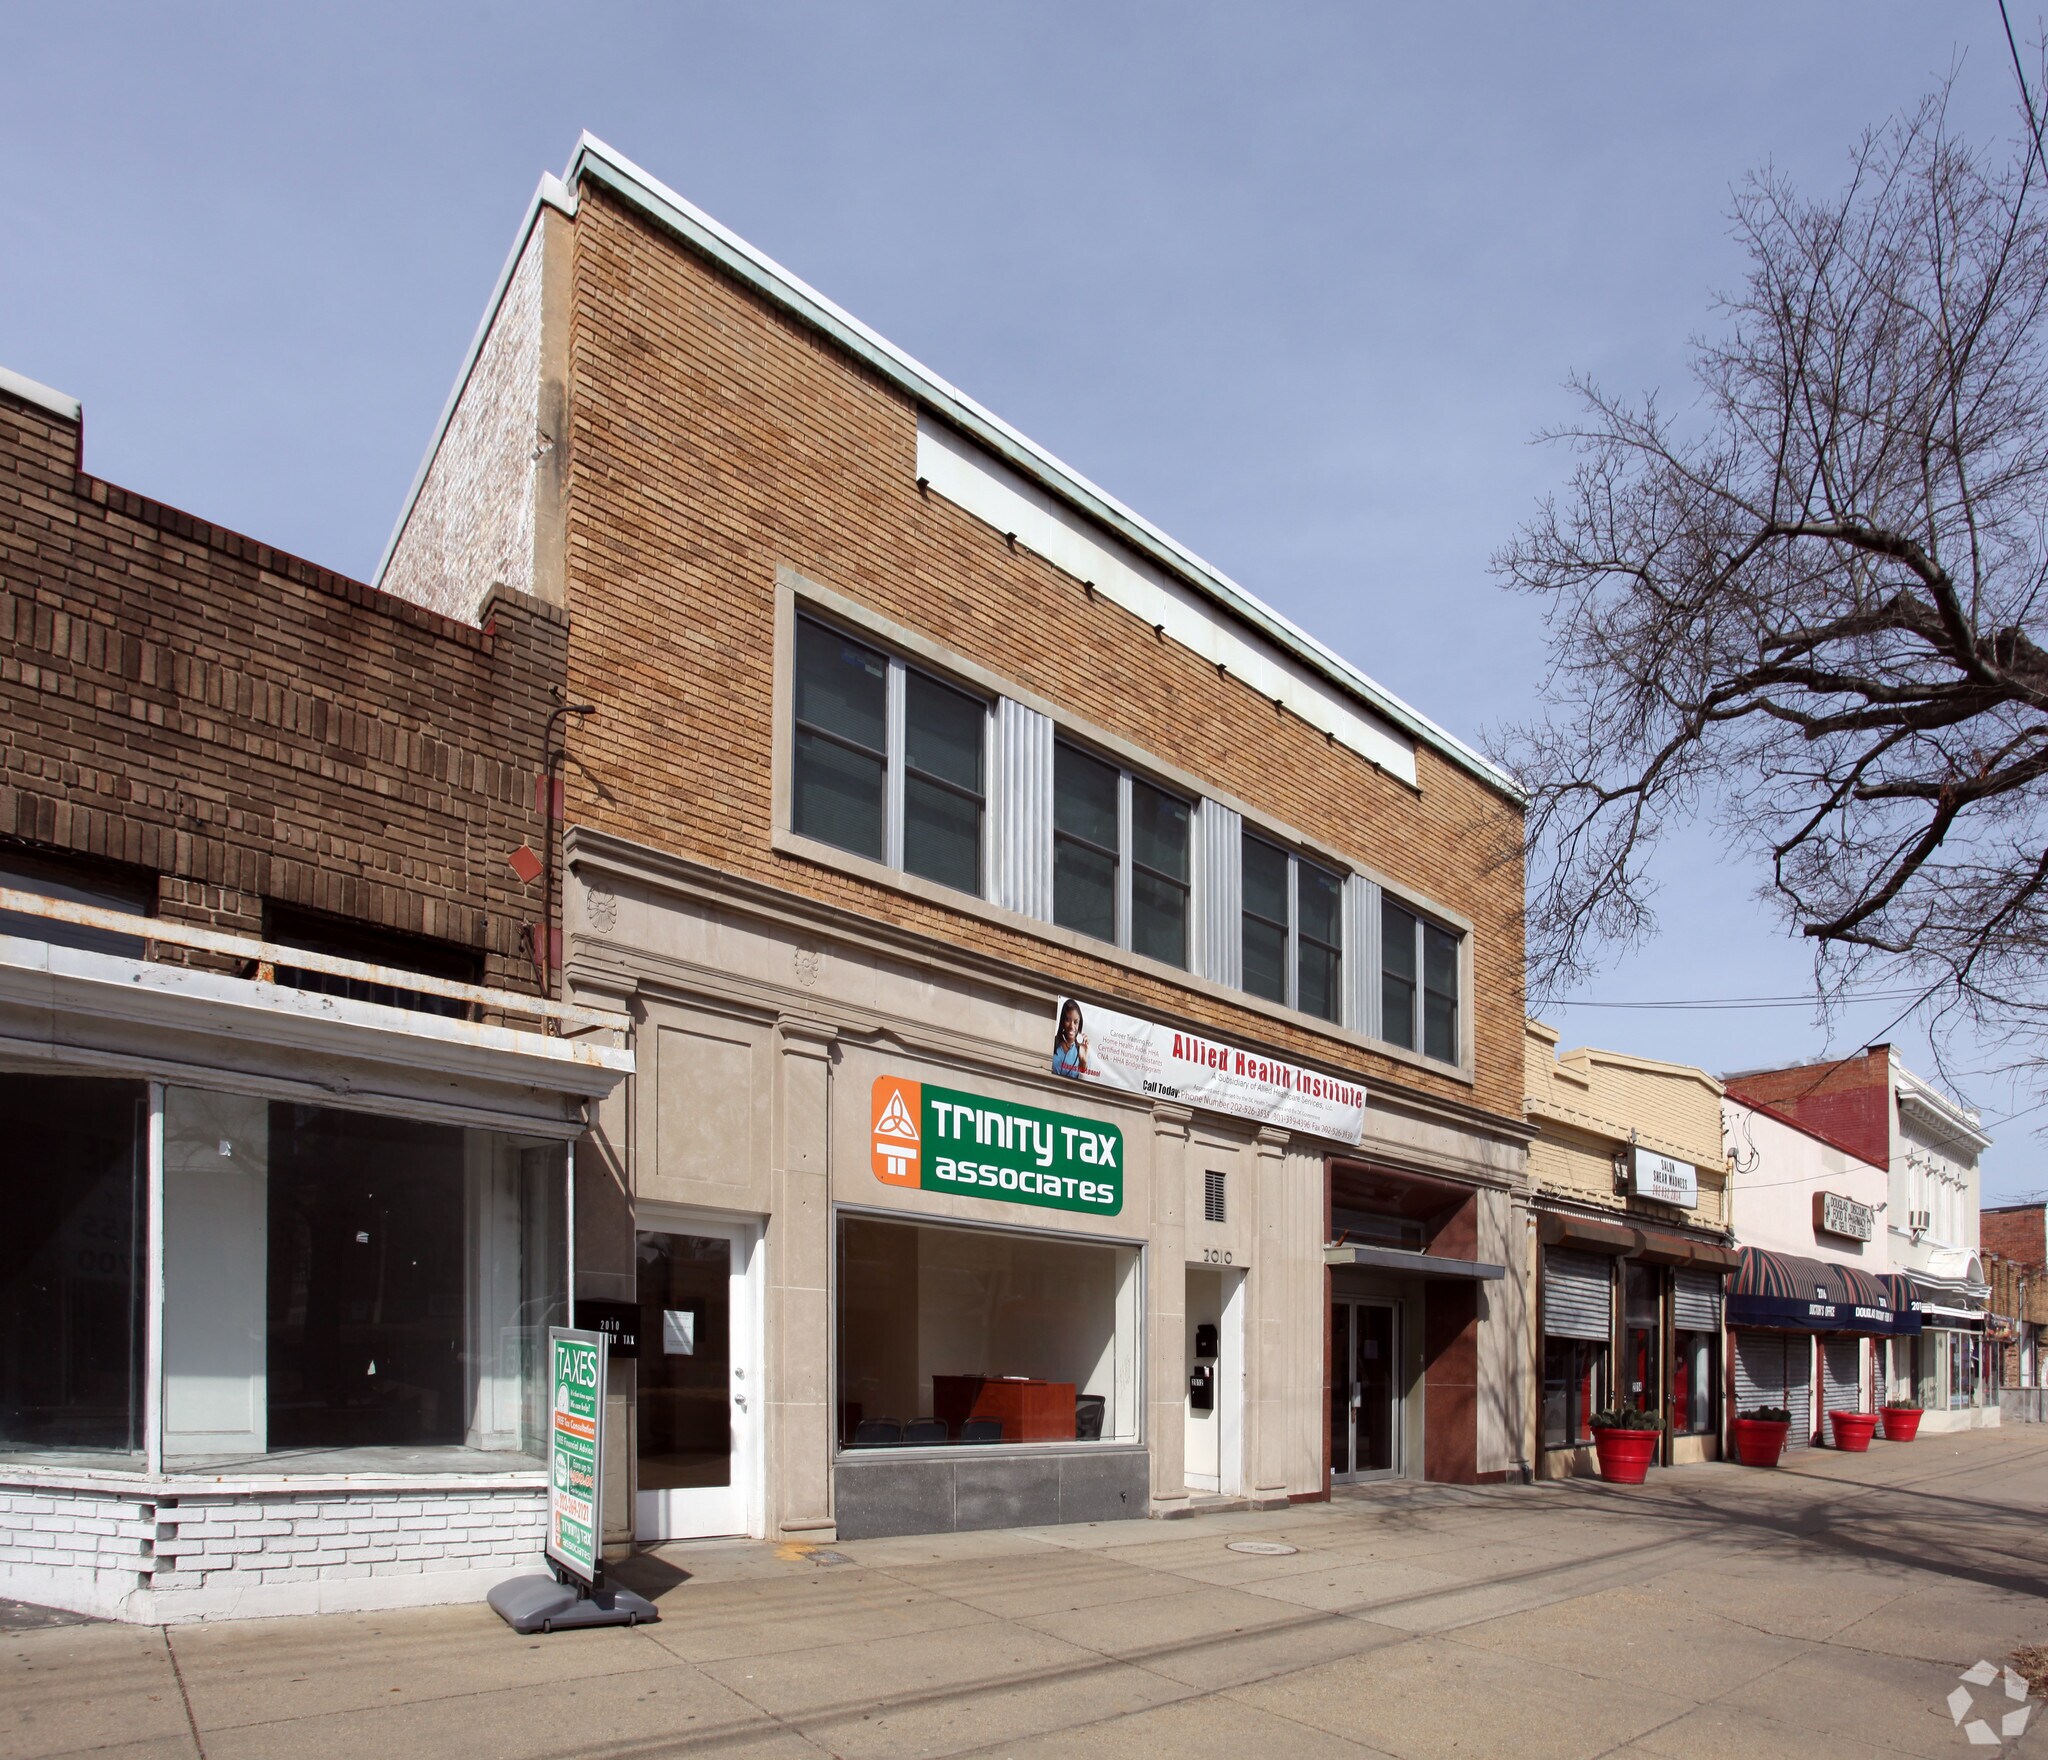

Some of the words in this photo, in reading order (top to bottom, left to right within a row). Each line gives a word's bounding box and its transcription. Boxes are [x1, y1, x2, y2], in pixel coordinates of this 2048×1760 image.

[1097, 1044, 1119, 1056] Certified
[1120, 1050, 1139, 1061] Nursing
[1102, 1036, 1118, 1046] Home
[1118, 1041, 1134, 1050] Health
[1097, 1052, 1109, 1062] CNA
[1113, 1056, 1125, 1065] HHA
[1126, 1059, 1141, 1071] Bridge
[1140, 1063, 1162, 1075] Program
[1172, 1033, 1228, 1072] Allied
[1235, 1051, 1291, 1089] Health
[1296, 1069, 1363, 1109] Institute
[1211, 1072, 1217, 1081] A
[1218, 1073, 1250, 1089] Subsidiary
[1250, 1082, 1257, 1090] of
[1257, 1083, 1273, 1095] Allied
[1273, 1089, 1301, 1103] Healthcare
[1142, 1079, 1158, 1092] Call
[1180, 1089, 1204, 1104] Phone
[1203, 1095, 1229, 1109] Number
[1311, 1121, 1321, 1132] Fax
[1661, 1159, 1675, 1174] SALON
[1653, 1169, 1667, 1184] SHEAR
[1669, 1174, 1688, 1190] MADNESS
[1830, 1196, 1848, 1212] DOUGLAS
[1851, 1203, 1868, 1217] DISCOUNT
[1833, 1208, 1843, 1221] FOOD
[1848, 1213, 1867, 1227] PHARMACY
[1831, 1218, 1837, 1230] WE
[1839, 1221, 1848, 1233] SELL
[1857, 1226, 1867, 1238] LESS
[1203, 1249, 1233, 1265] 2010
[1809, 1303, 1824, 1317] DOCTOR'S
[1825, 1305, 1836, 1317] OFFICE
[1855, 1306, 1875, 1318] DOUGLAS
[600, 1319, 620, 1331] 2010
[623, 1334, 635, 1345] TAX
[557, 1346, 597, 1388] TAXES
[556, 1414, 565, 1426] FREE
[570, 1419, 595, 1435] Consultation
[556, 1433, 564, 1445] FREE
[563, 1437, 579, 1450] Financial
[579, 1442, 594, 1455] Advice
